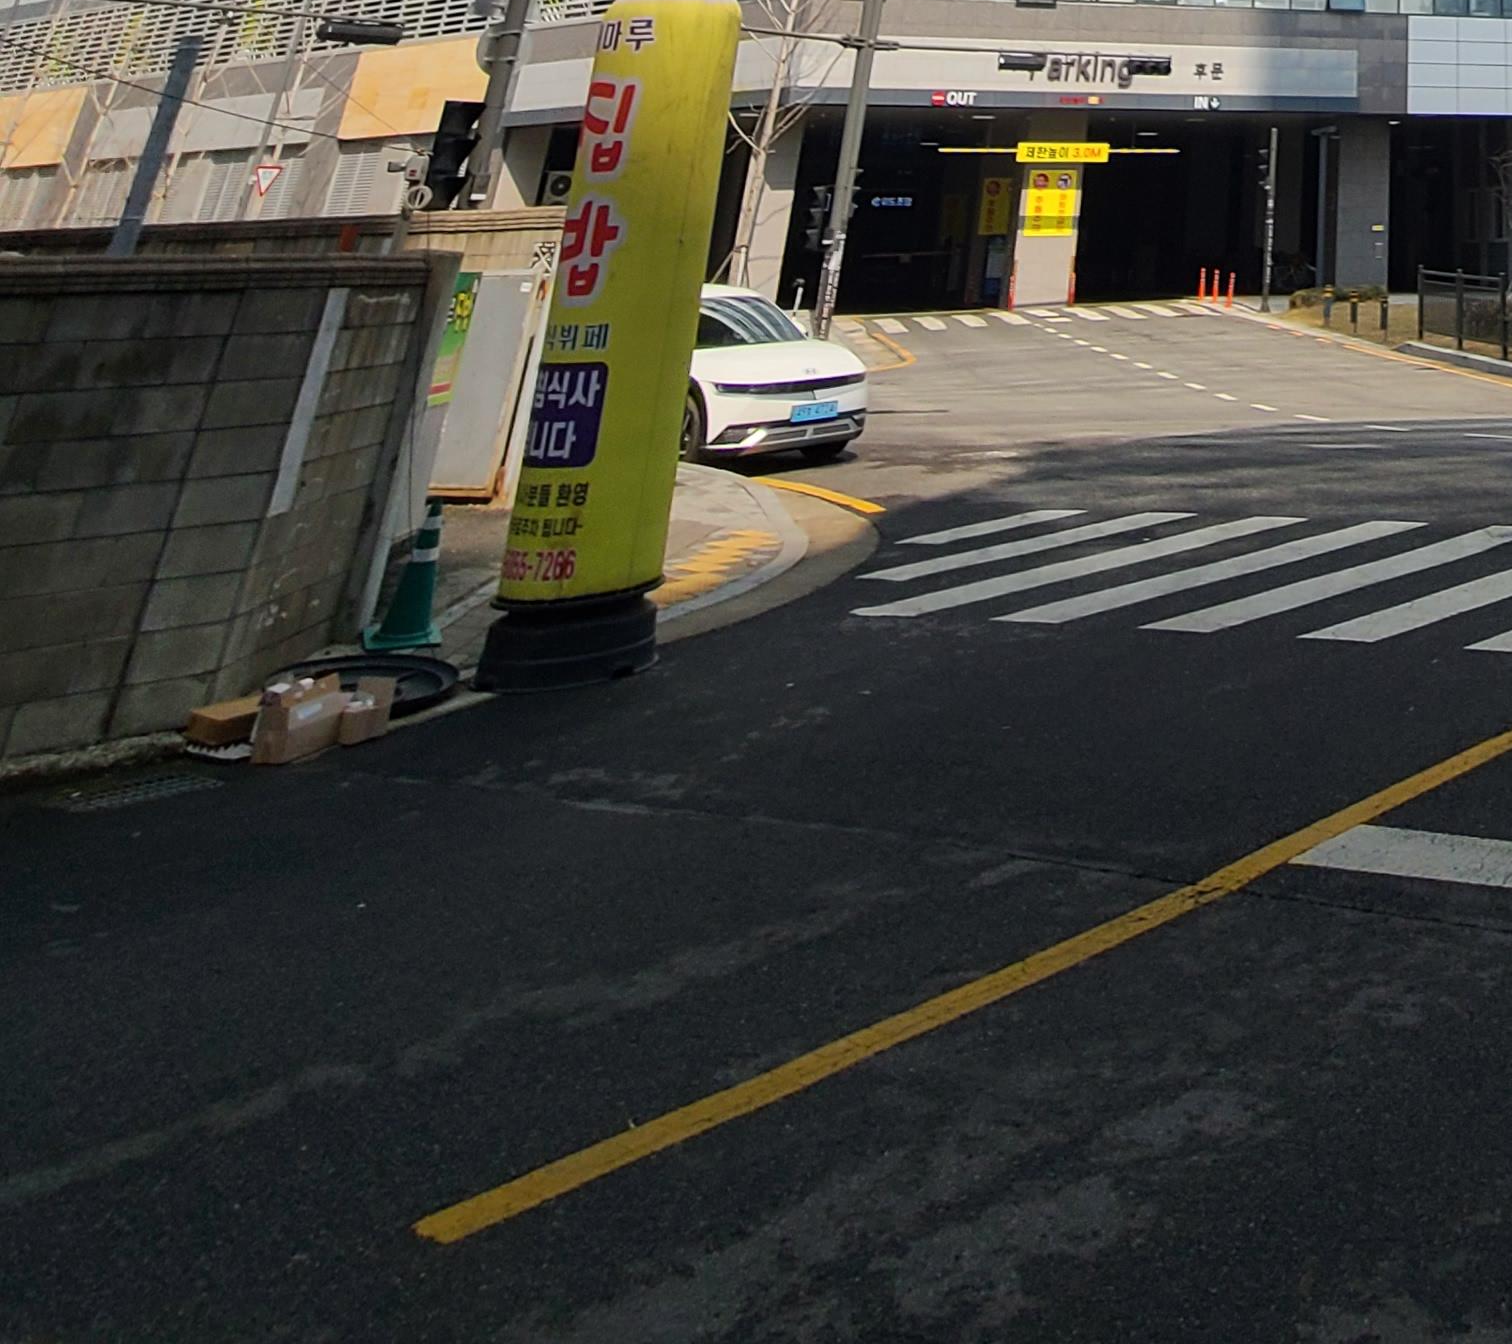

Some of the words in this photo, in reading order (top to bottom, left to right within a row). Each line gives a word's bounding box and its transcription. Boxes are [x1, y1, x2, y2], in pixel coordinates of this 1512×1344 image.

[597, 18, 655, 51] 마루
[1029, 53, 1133, 88] arking
[1193, 62, 1224, 80] 후문
[946, 91, 978, 106] OUT
[1193, 95, 1210, 110] IN
